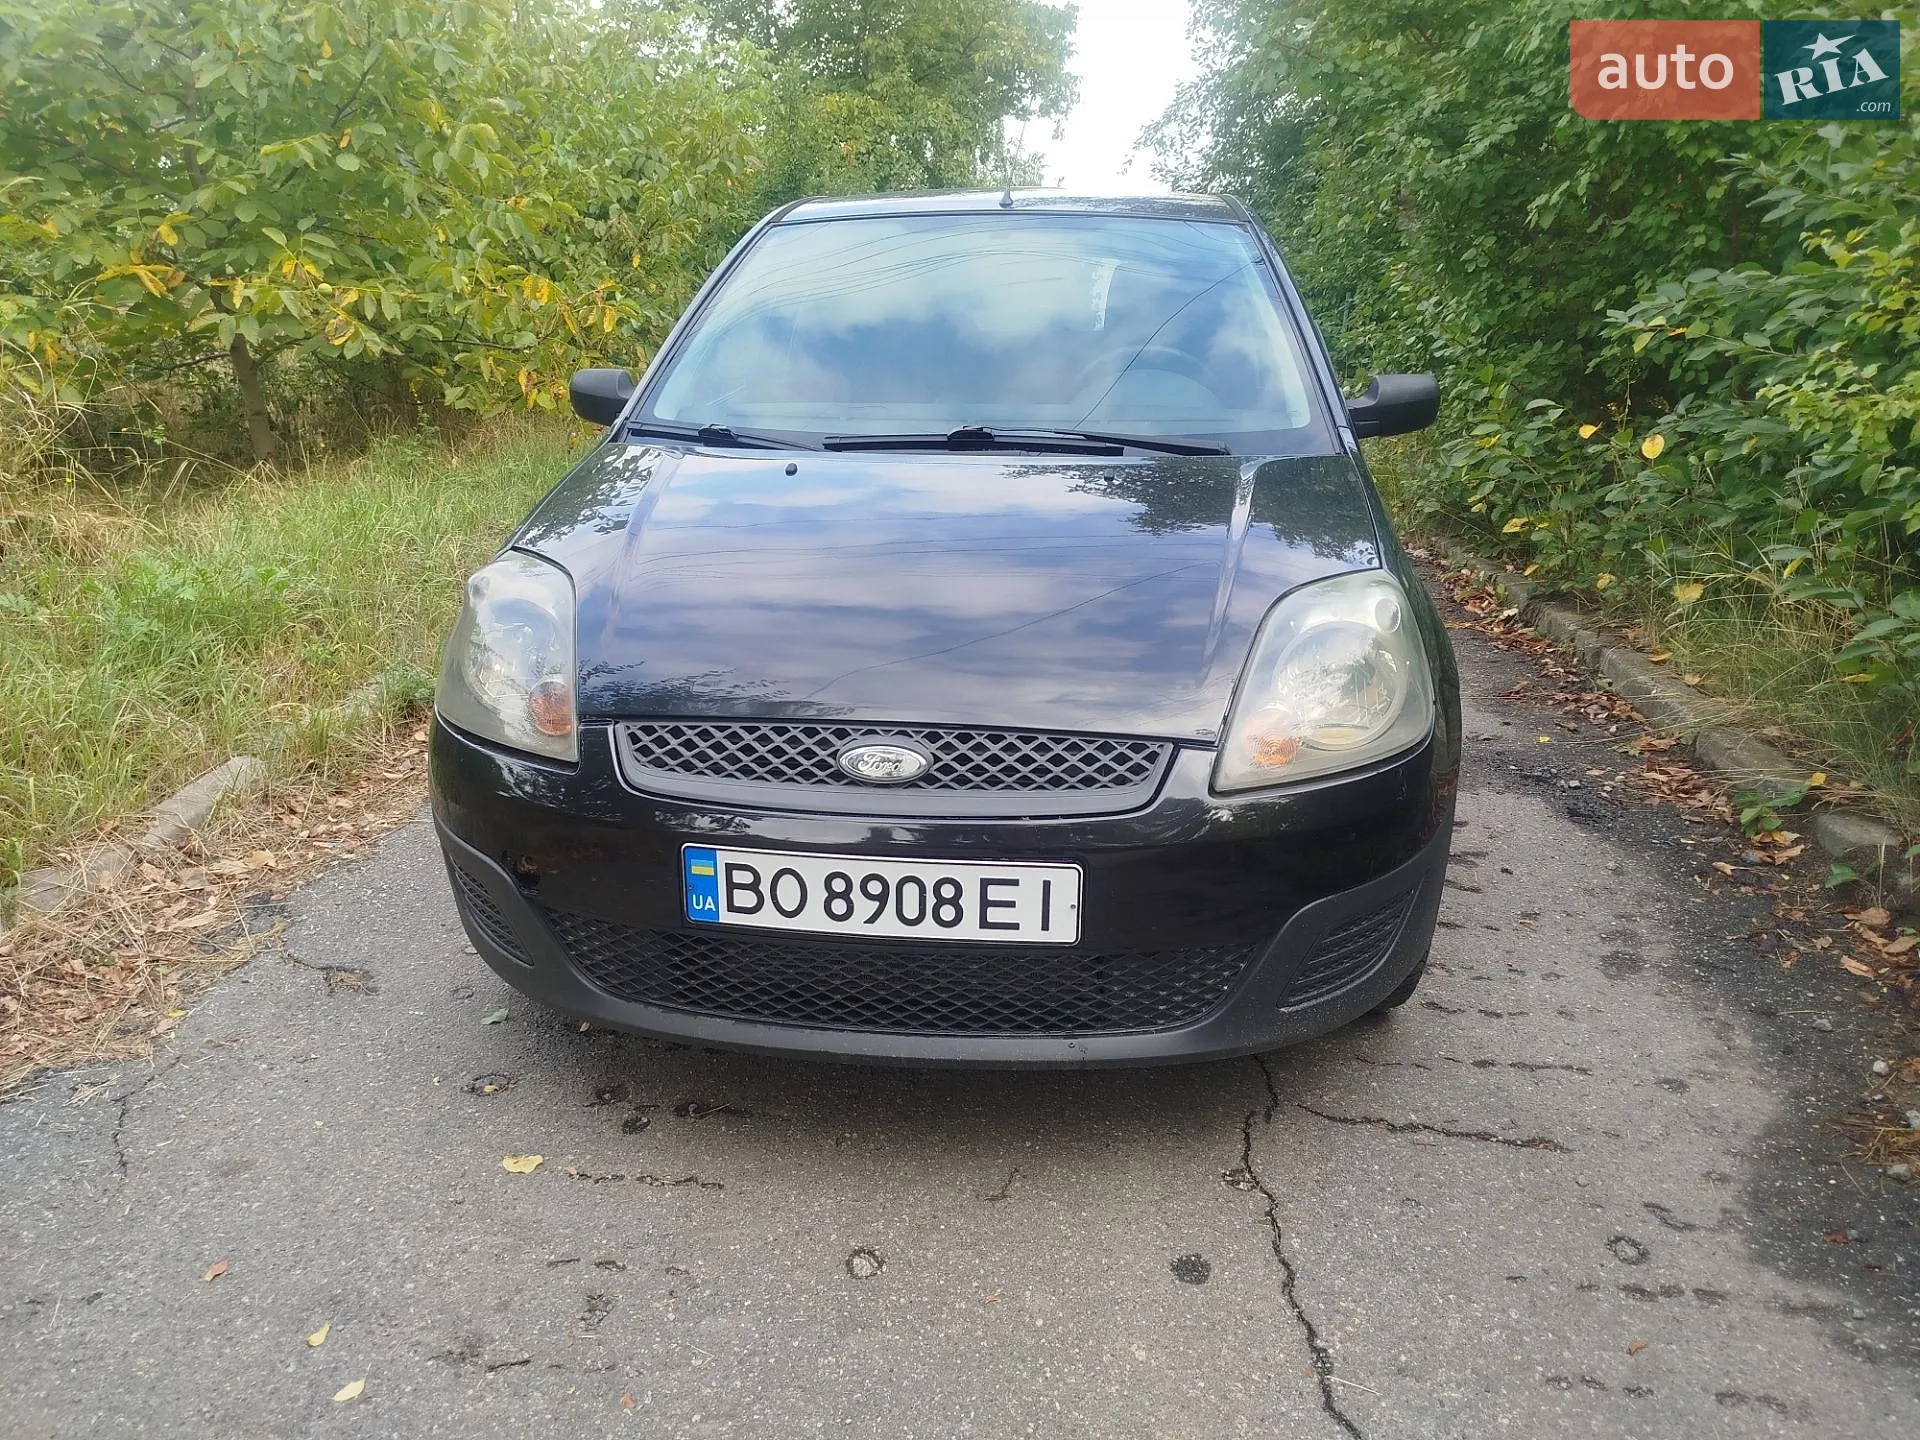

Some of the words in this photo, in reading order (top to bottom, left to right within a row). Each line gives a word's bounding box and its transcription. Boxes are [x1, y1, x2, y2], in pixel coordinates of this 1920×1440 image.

[691, 893, 717, 912] UA
[724, 862, 808, 919] BO
[823, 871, 964, 929] 8908
